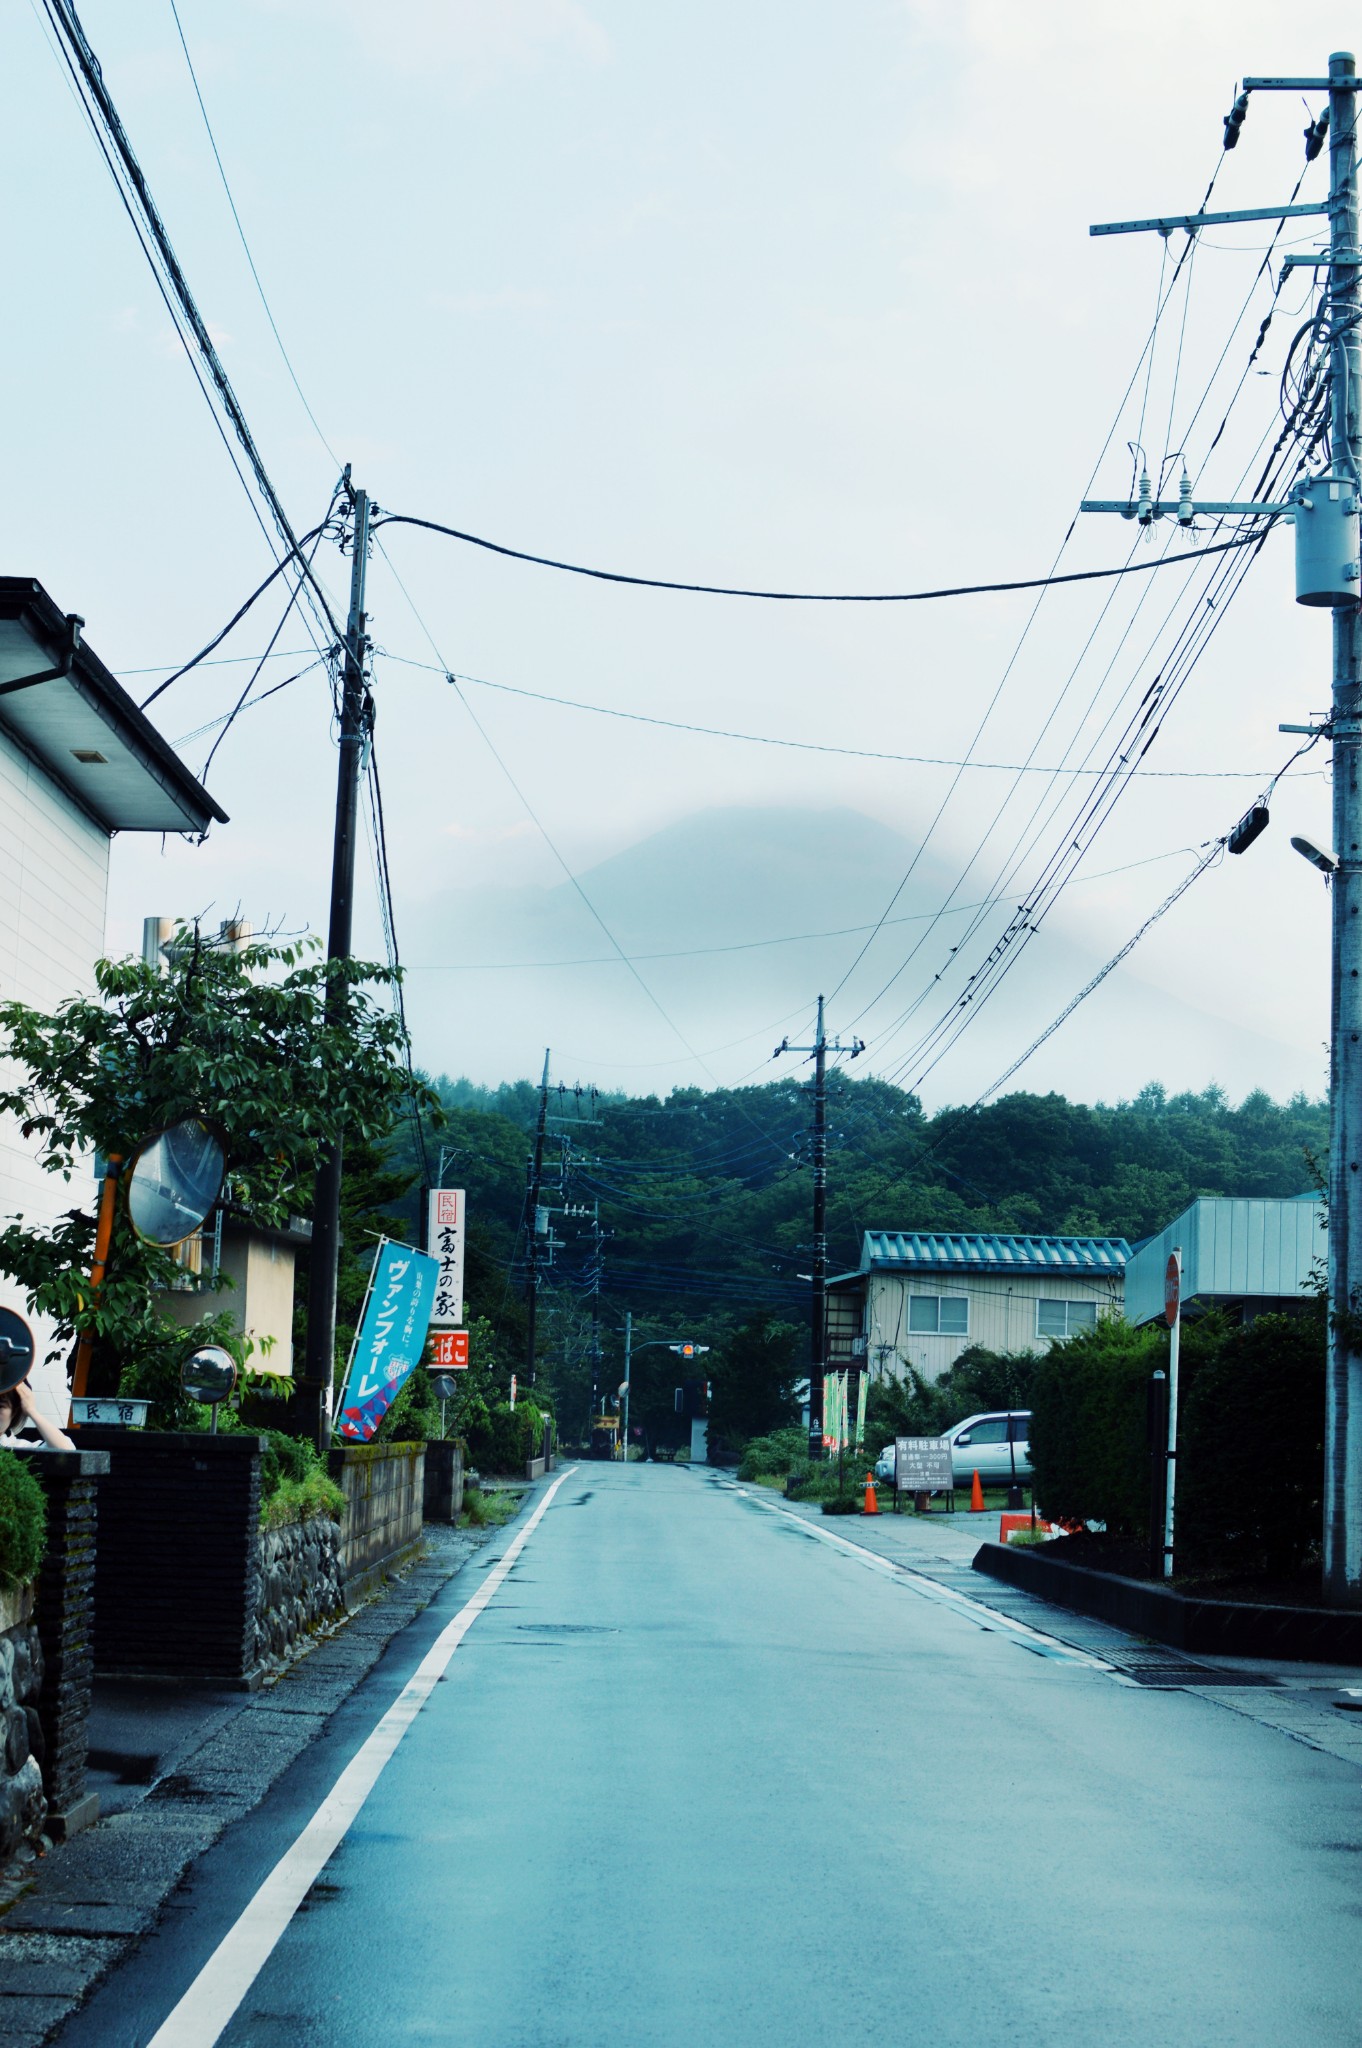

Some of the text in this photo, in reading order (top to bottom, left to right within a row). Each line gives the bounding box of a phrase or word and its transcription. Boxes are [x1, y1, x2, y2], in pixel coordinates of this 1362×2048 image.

[440, 1194, 455, 1222] 民宿
[434, 1226, 458, 1317] 富士の家
[357, 1260, 411, 1398] ヴァンフォーレ
[897, 1439, 950, 1452] 有料駐車場
